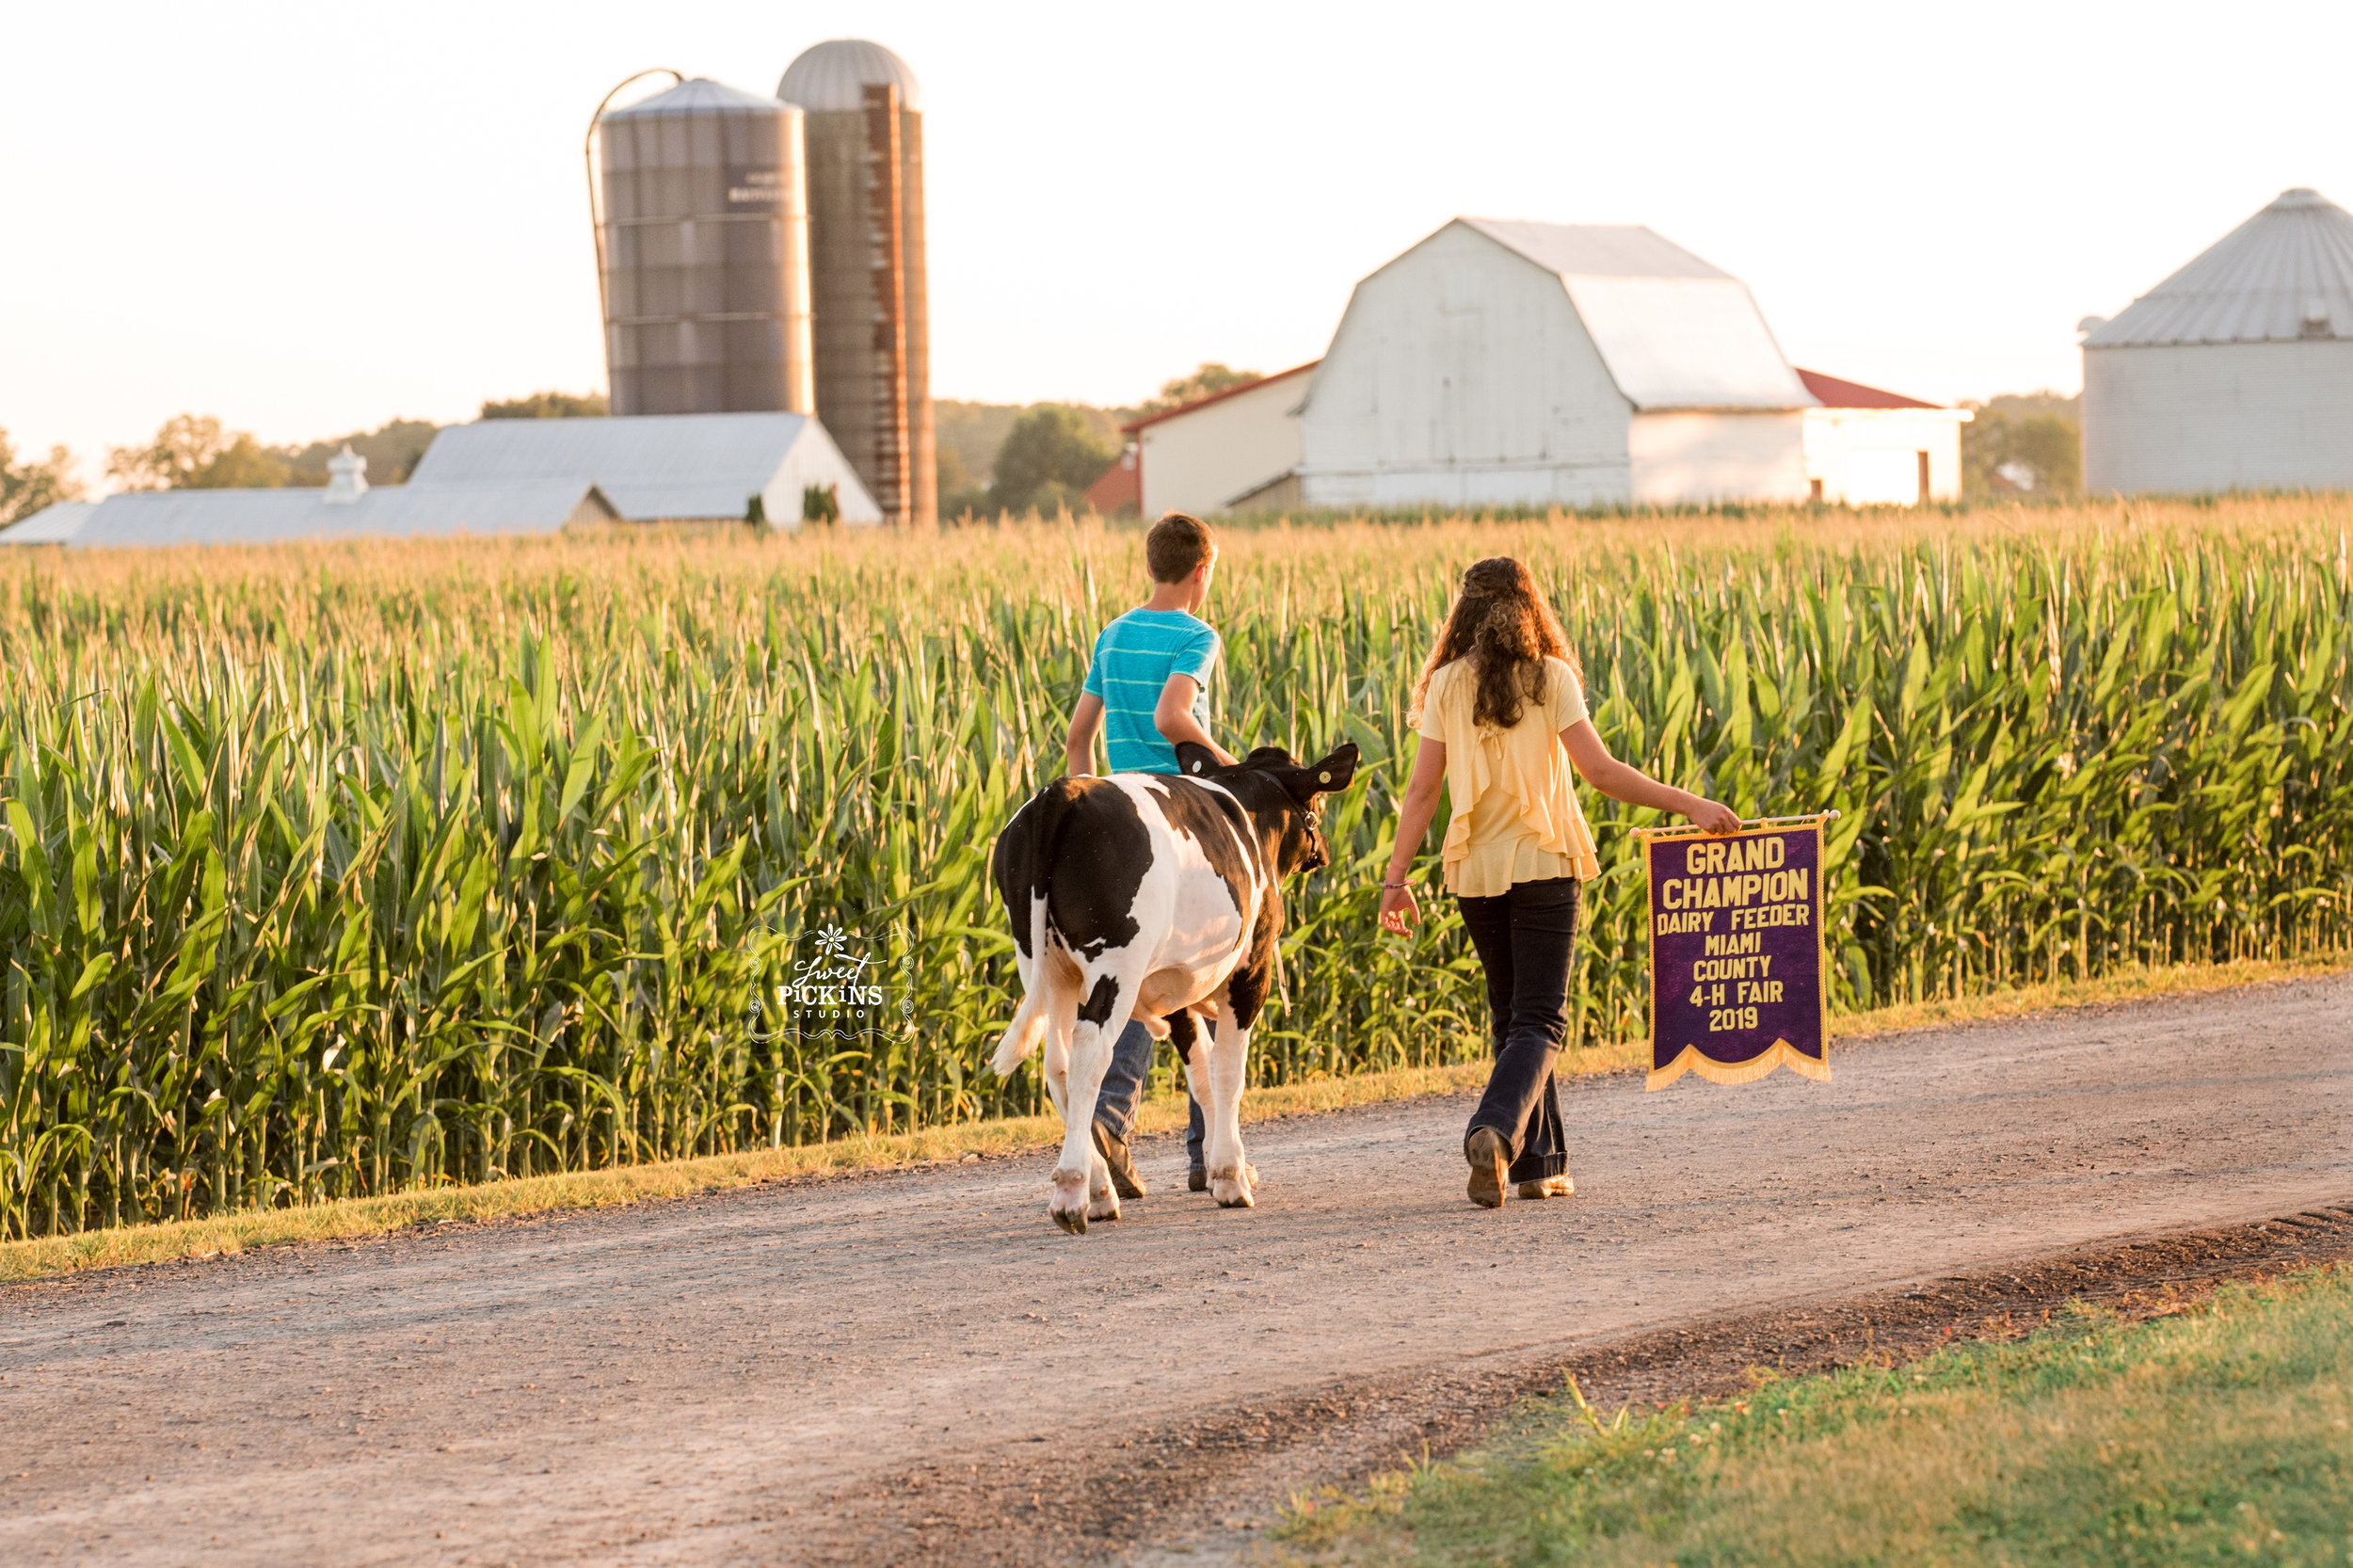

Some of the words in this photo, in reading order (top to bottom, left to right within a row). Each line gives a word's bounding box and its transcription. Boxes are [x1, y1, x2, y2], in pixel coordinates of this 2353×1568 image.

[1686, 836, 1785, 875] GRAND
[1662, 867, 1809, 910] CHAMPION
[1657, 911, 1715, 936] DAIRY
[1730, 903, 1810, 931] FEEDER
[1705, 931, 1762, 956] MIAMI
[1692, 954, 1772, 983] COUNTY
[1689, 982, 1725, 1008] 4-H
[1737, 981, 1784, 1005] FAIR
[1709, 1006, 1758, 1032] 2019
